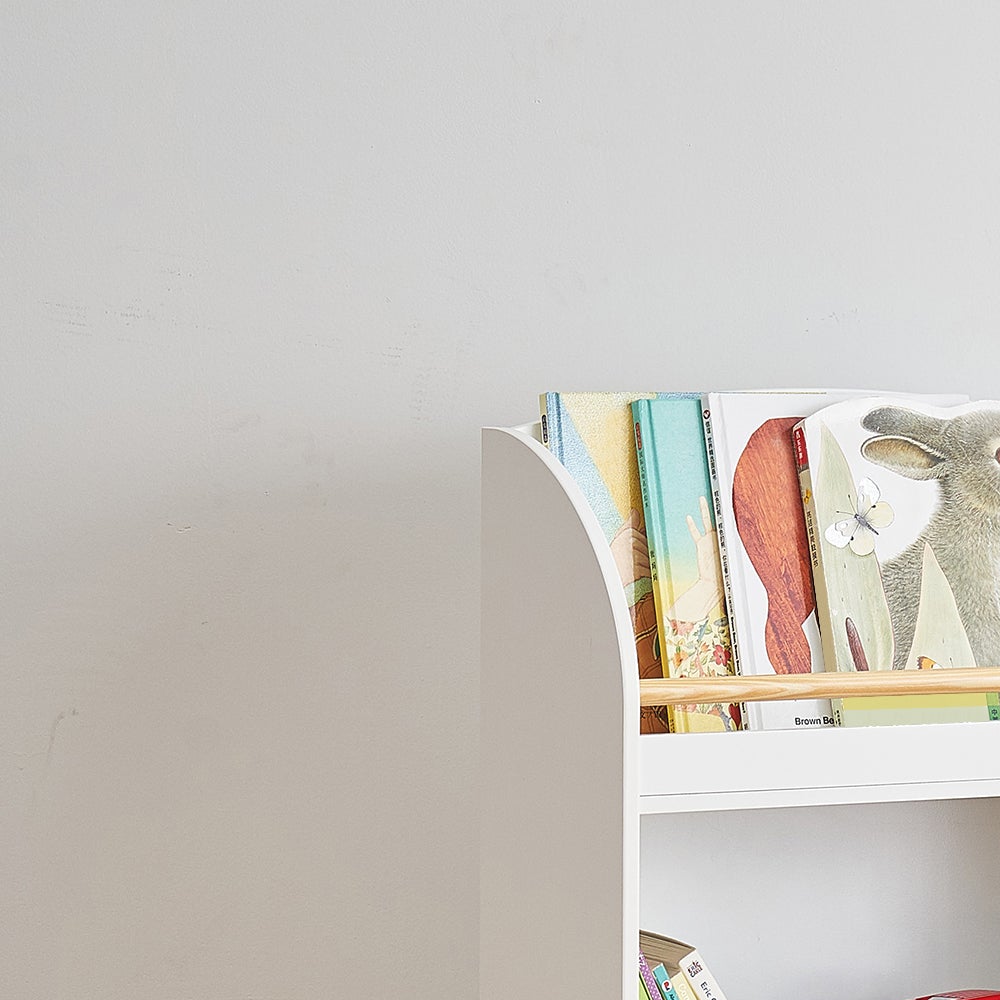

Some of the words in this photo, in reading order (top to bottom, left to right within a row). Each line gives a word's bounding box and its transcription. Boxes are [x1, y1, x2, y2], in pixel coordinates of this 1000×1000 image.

[794, 716, 822, 726] Brown
[822, 716, 835, 726] Be
[700, 981, 711, 998] Eric
